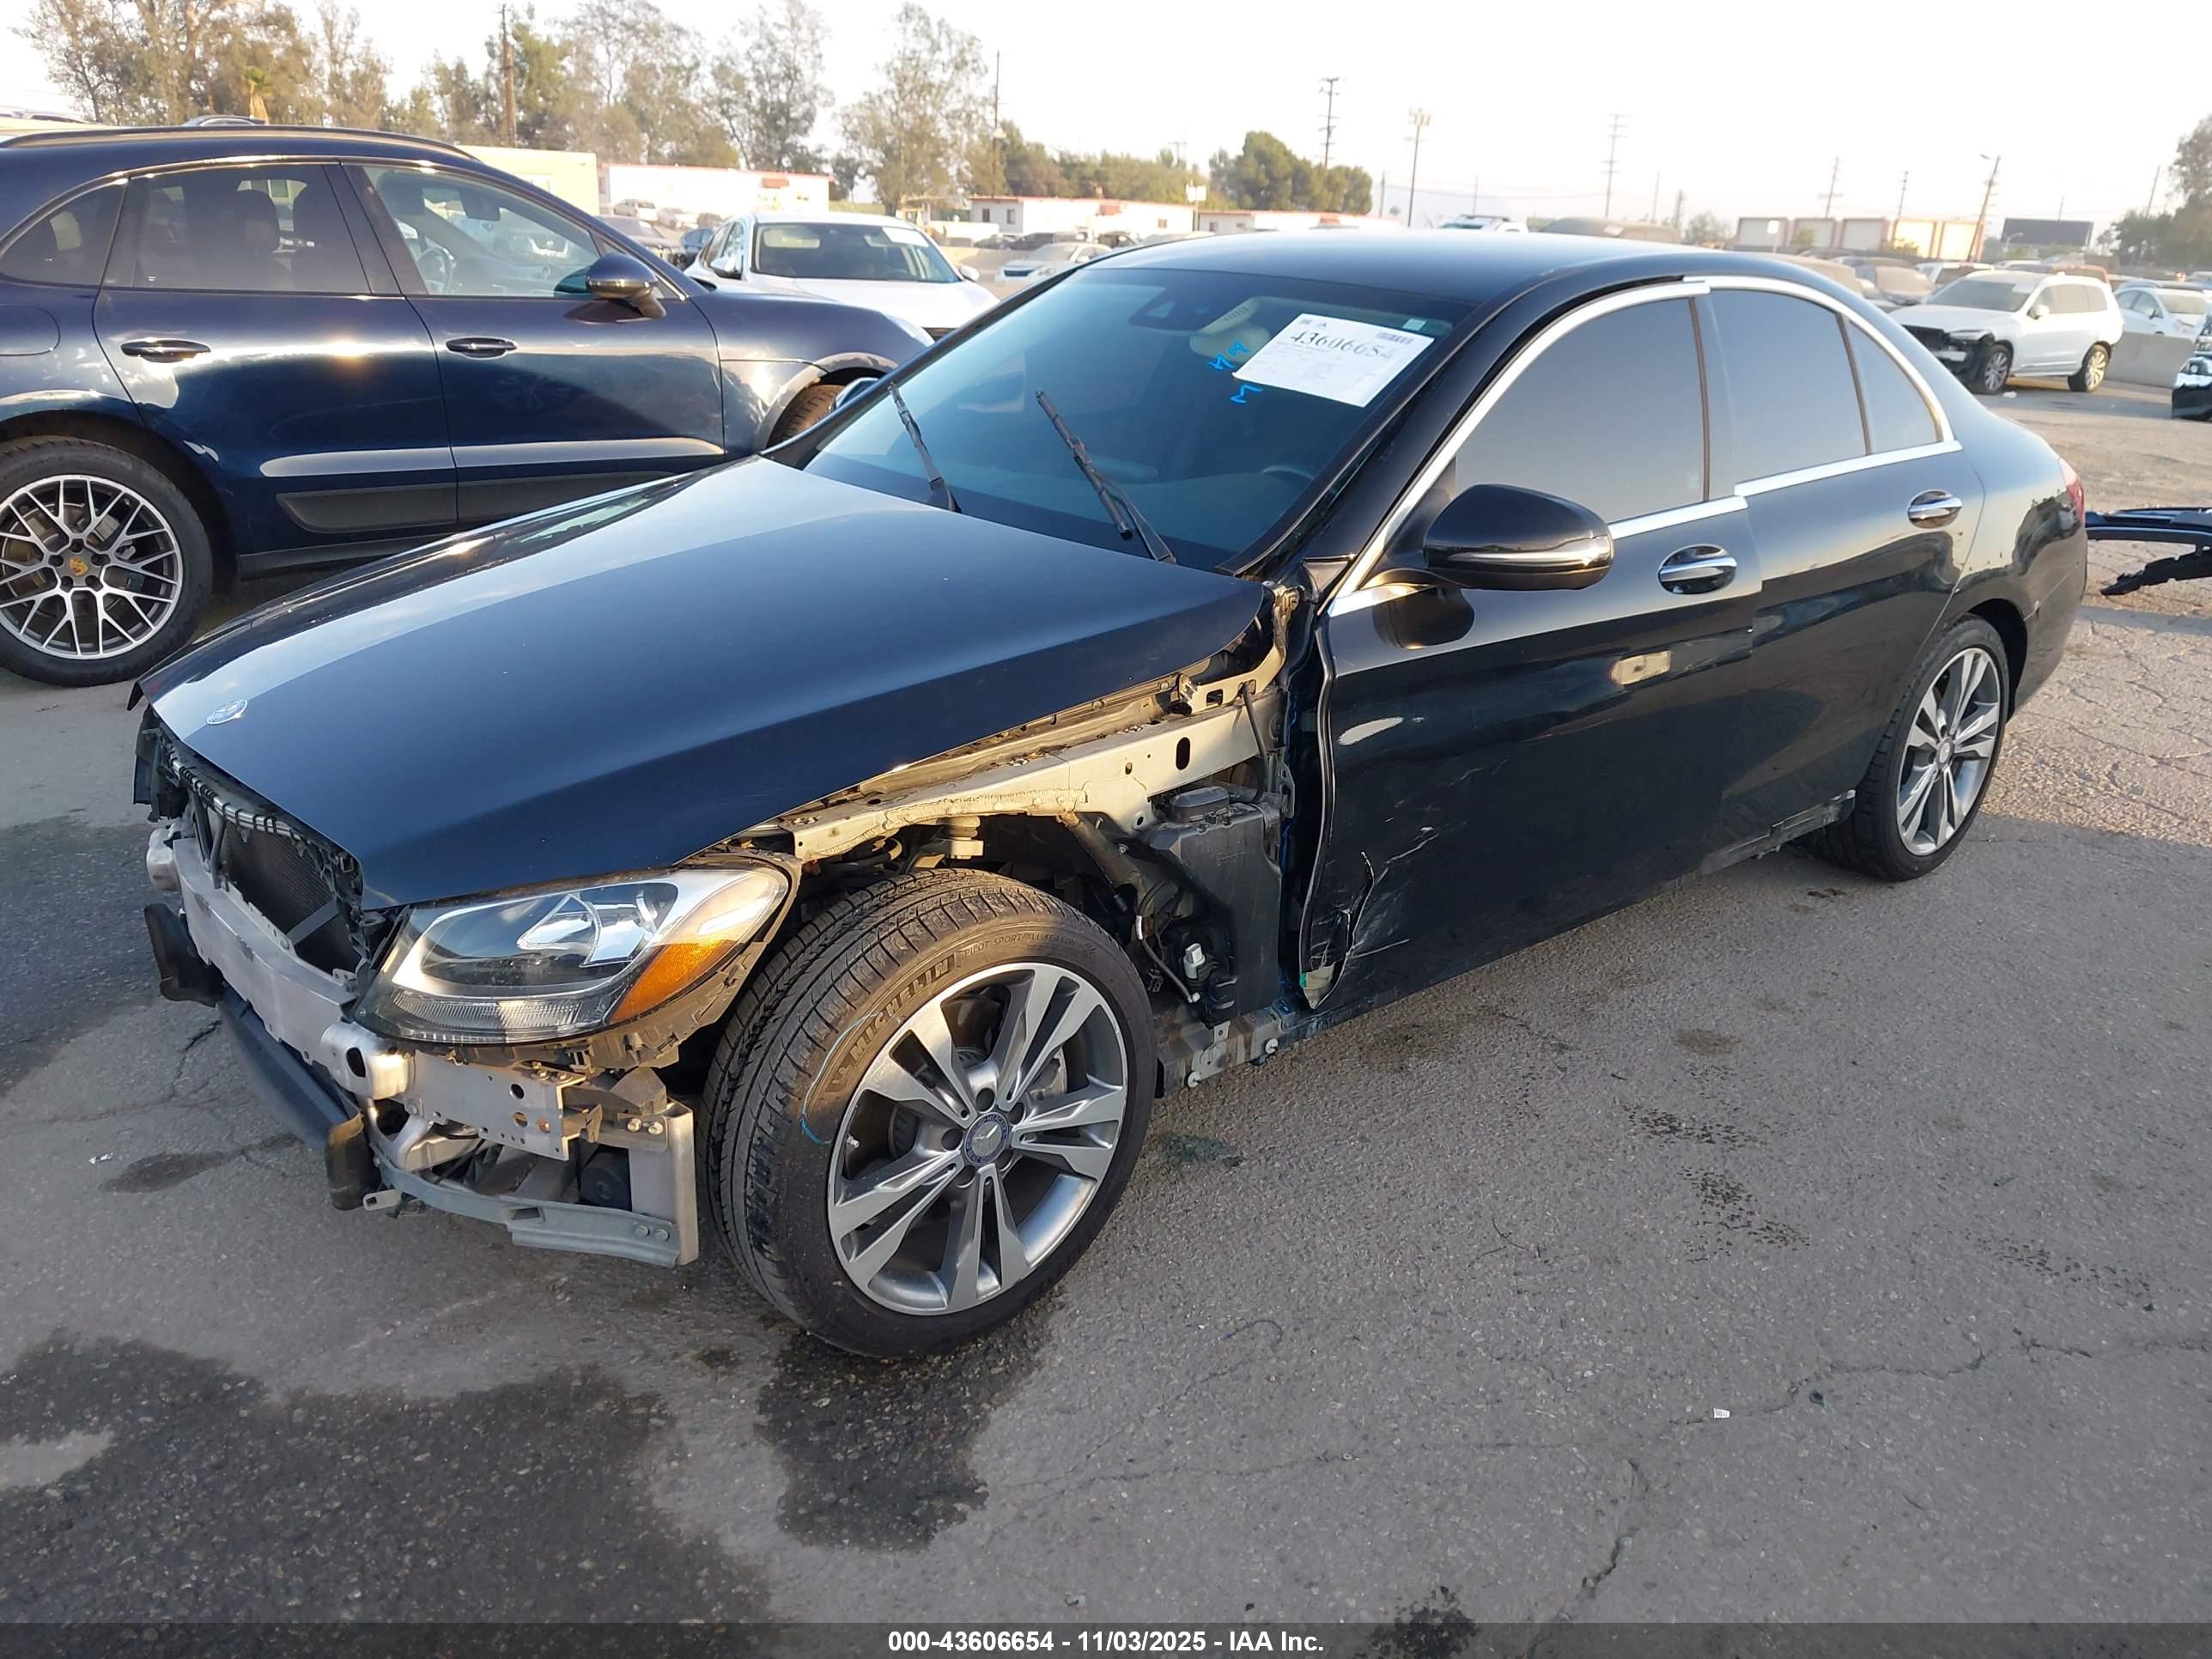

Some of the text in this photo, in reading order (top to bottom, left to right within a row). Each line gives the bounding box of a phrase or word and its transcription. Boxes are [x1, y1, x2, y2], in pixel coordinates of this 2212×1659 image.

[963, 940, 989, 957] PILOT
[994, 933, 1022, 945] SPORT
[1024, 933, 1040, 943] ALL
[850, 958, 950, 1061] MICHELIN
